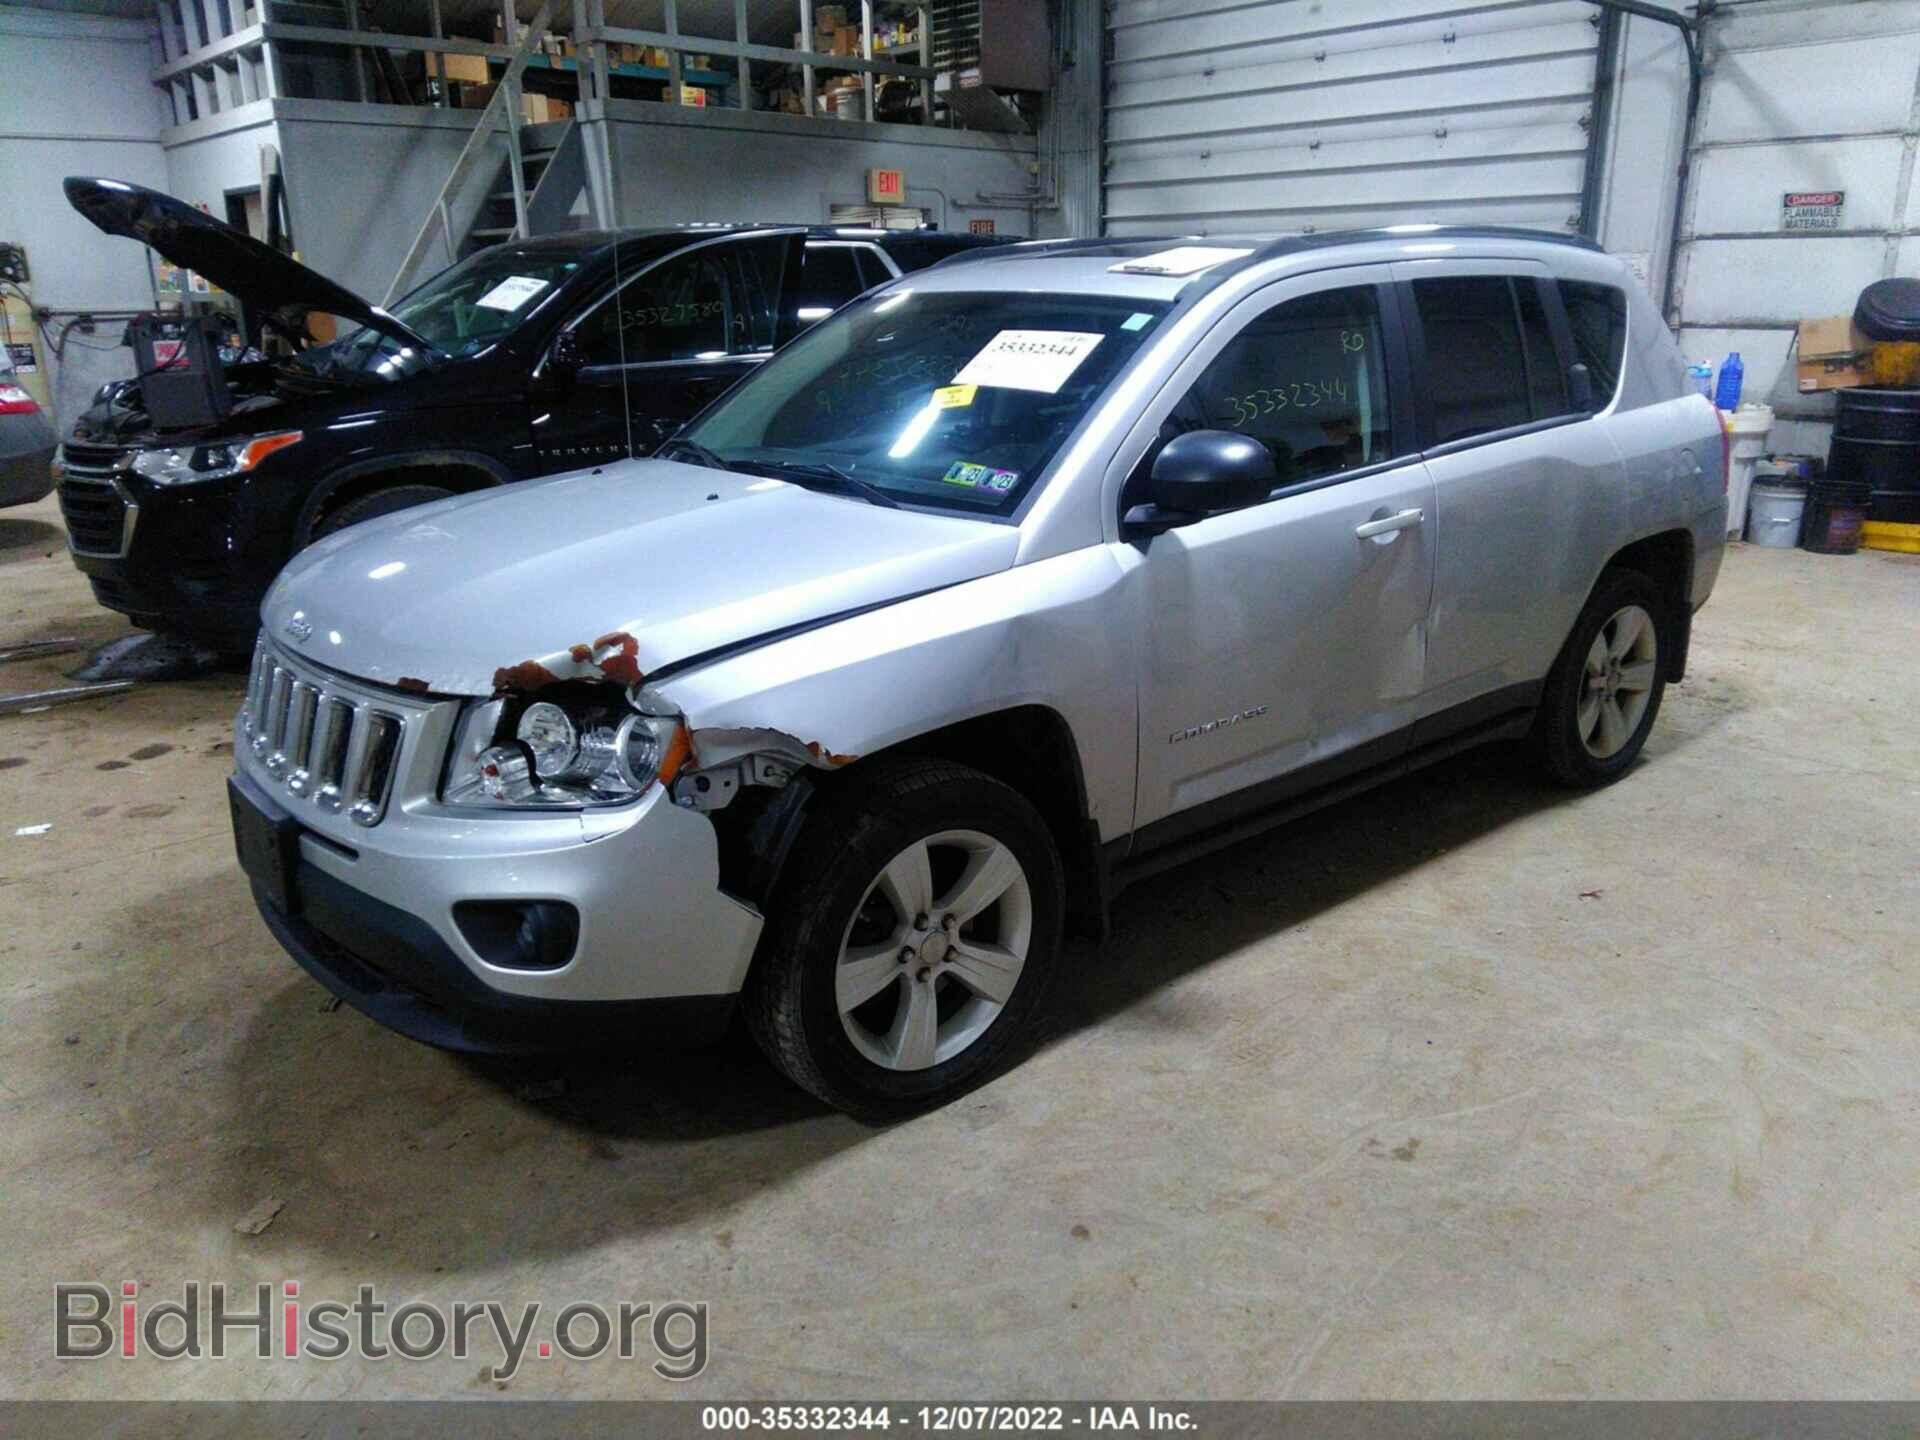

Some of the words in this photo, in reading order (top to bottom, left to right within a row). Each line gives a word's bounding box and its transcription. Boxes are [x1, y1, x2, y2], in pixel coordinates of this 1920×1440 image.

[1790, 194, 1837, 205] DANGER
[1783, 207, 1842, 218] FLAMMABLE
[970, 220, 993, 233] FIRE
[1784, 218, 1839, 229] MATERIALS
[991, 341, 1078, 357] 35332344
[1223, 378, 1347, 428] 35332344
